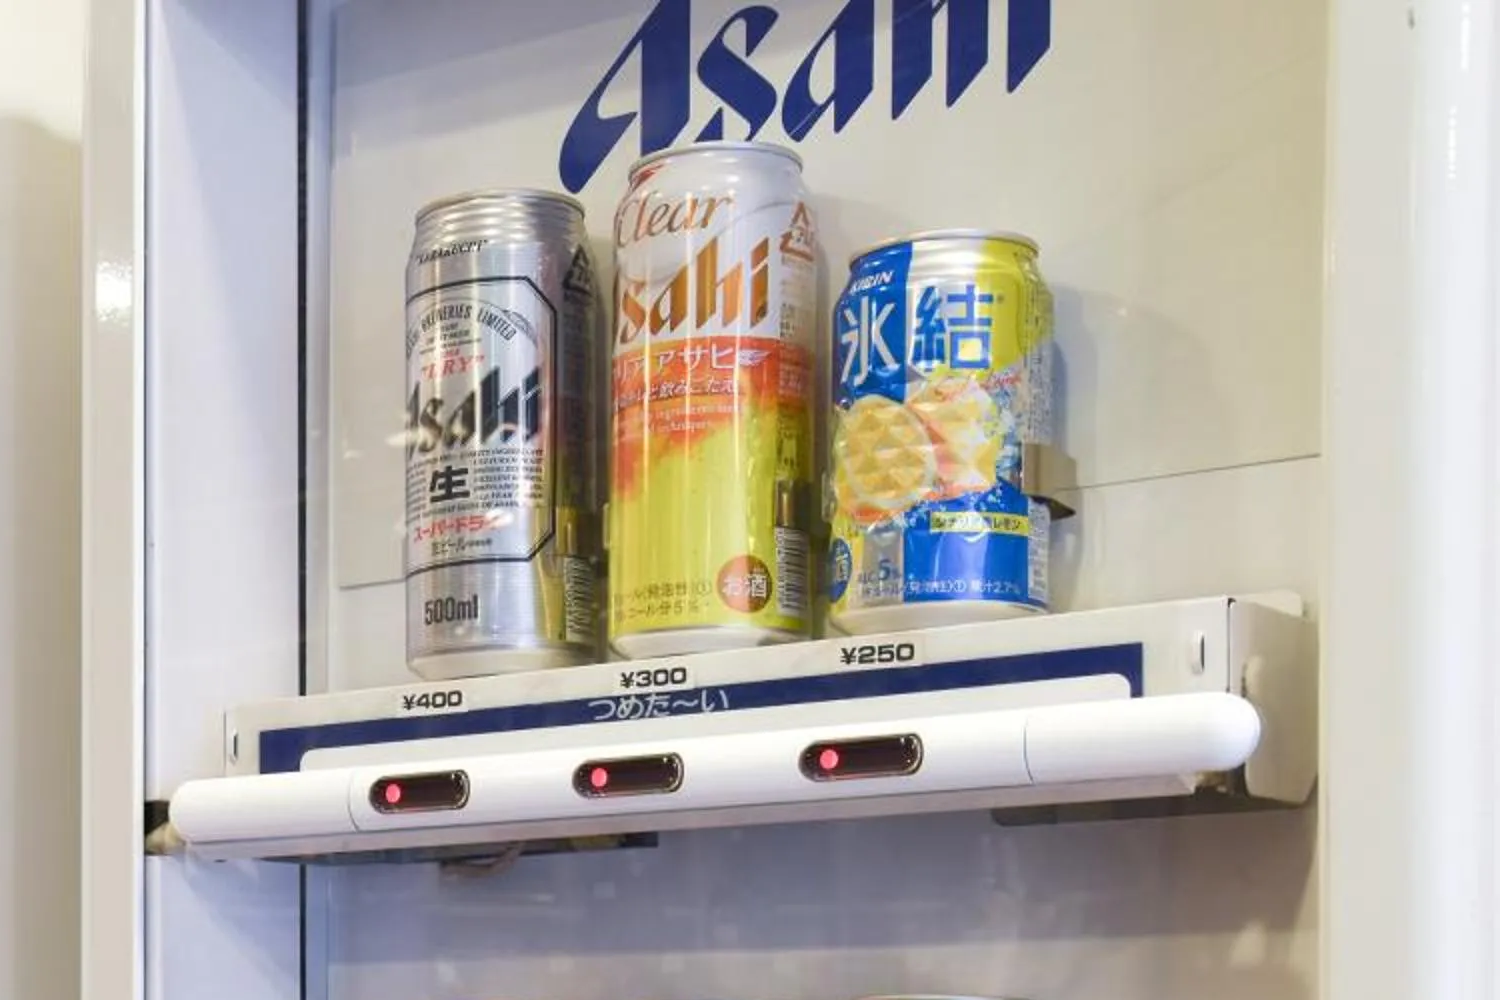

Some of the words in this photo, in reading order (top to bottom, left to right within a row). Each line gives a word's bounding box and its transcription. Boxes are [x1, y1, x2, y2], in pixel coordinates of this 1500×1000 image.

[614, 190, 736, 249] Clear
[616, 236, 769, 344] sahi
[476, 307, 518, 342] LIMITED
[839, 282, 995, 387] 氷結
[429, 465, 470, 503] 生
[425, 594, 479, 626] 500ml
[841, 643, 915, 665] ¥250
[620, 667, 687, 688] ¥300
[402, 690, 463, 711] ¥400
[587, 689, 731, 720] つめた〜い
